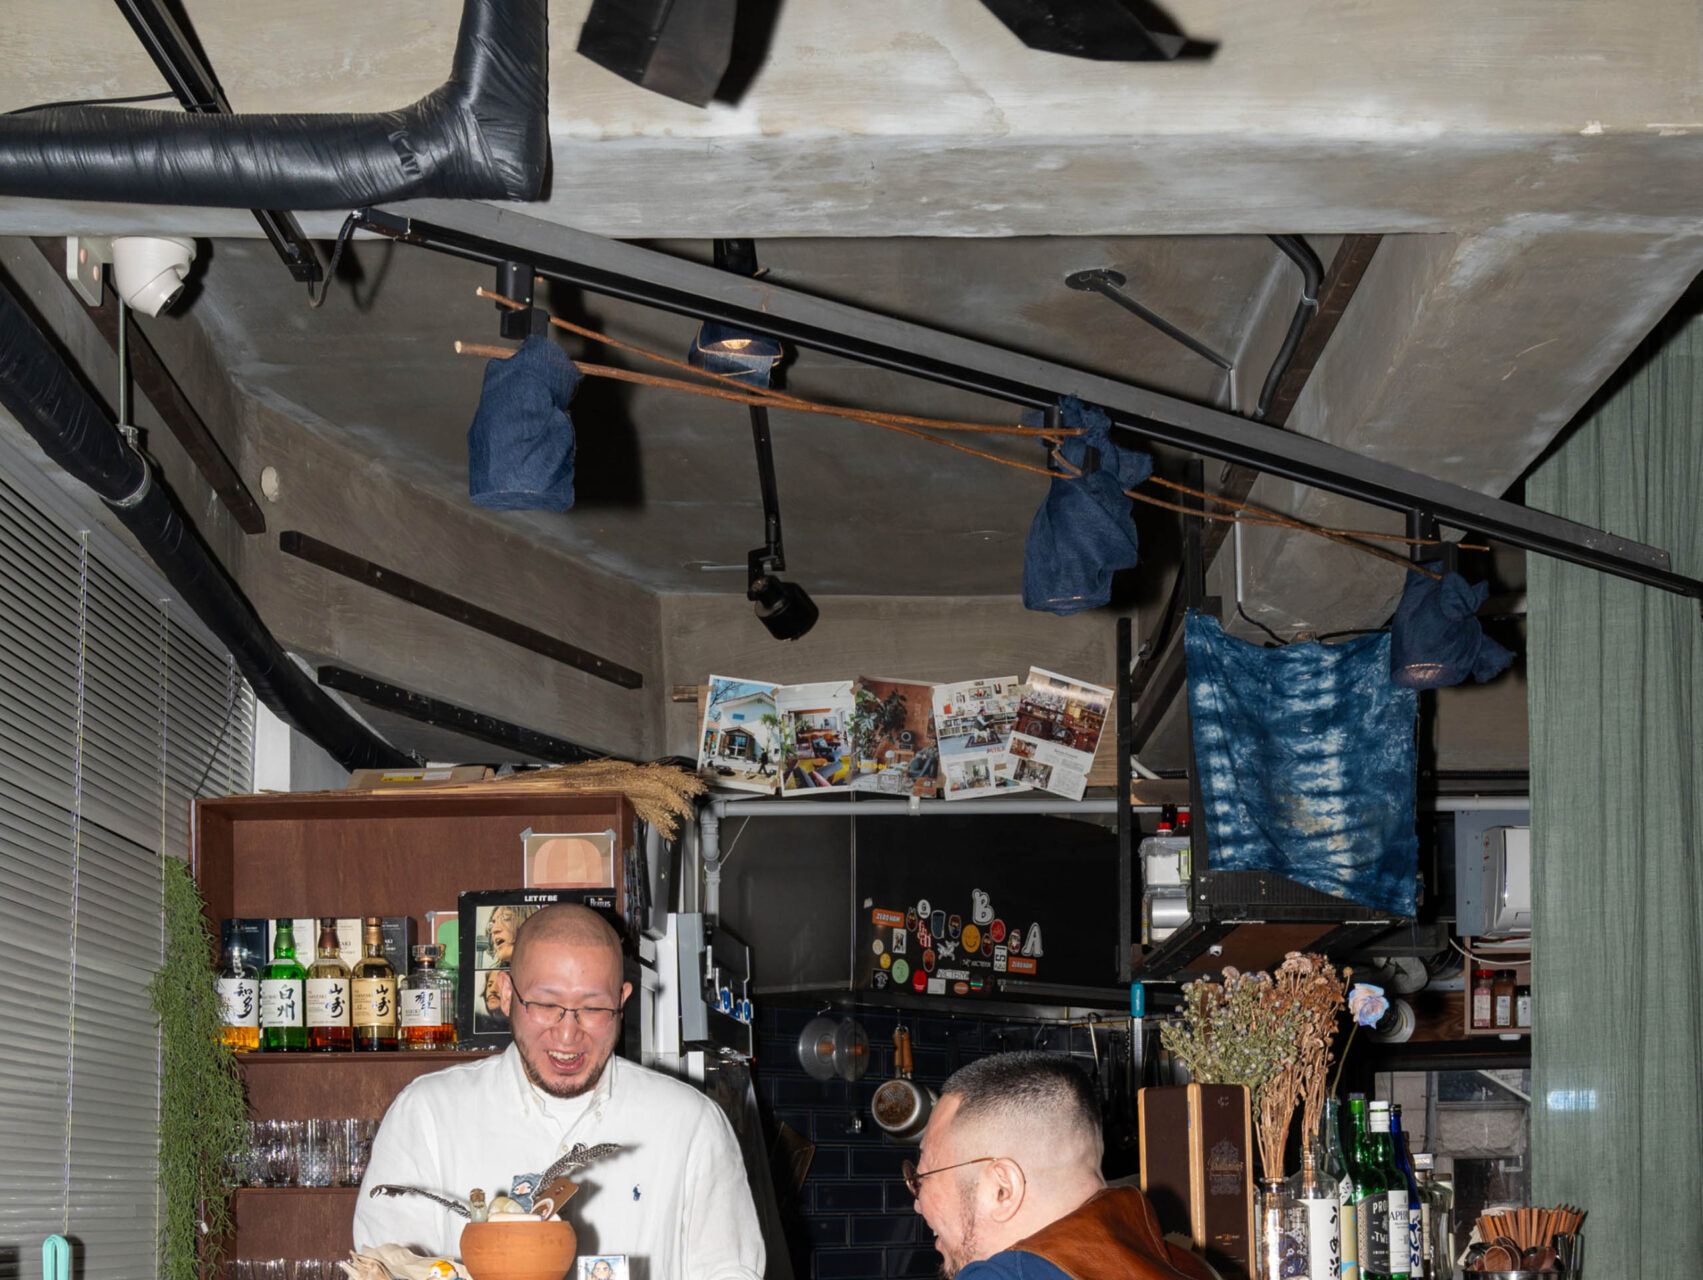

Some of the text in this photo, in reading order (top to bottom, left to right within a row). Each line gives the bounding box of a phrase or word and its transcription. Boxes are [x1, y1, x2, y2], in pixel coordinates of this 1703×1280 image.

[524, 894, 558, 902] LET IT BE
[973, 889, 994, 925] B
[1022, 922, 1043, 957] A
[233, 982, 254, 1018] 知多
[277, 984, 296, 1020] 白州
[326, 983, 345, 1018] 山崎
[375, 984, 391, 1017] 山崎
[1372, 1200, 1389, 1214] PRO
